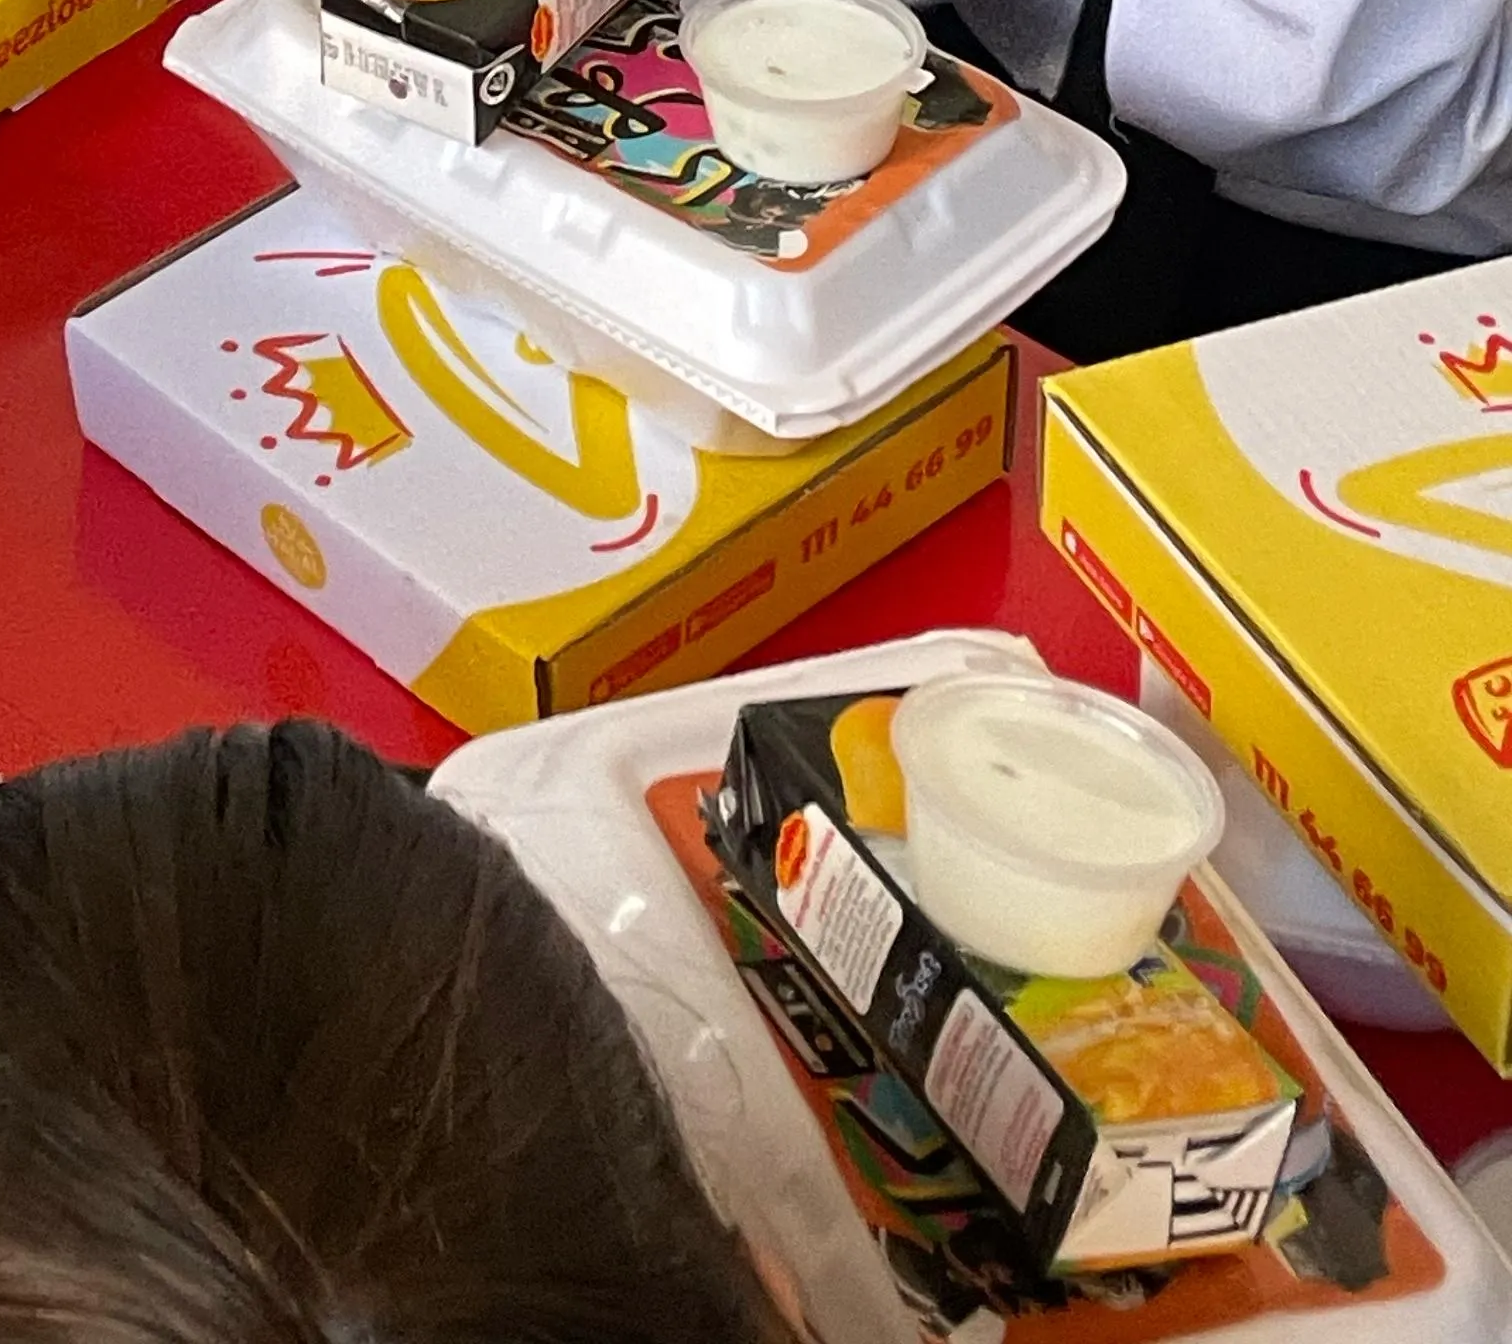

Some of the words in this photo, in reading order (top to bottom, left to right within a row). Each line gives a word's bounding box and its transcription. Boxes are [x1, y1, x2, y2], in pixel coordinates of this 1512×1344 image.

[801, 517, 839, 563] 111
[850, 484, 893, 527] 44
[904, 446, 945, 491] 66
[954, 414, 994, 460] 99
[1252, 744, 1290, 812] 111
[1299, 808, 1343, 872] 44
[1351, 868, 1394, 933] 66
[1403, 927, 1447, 994] 99
